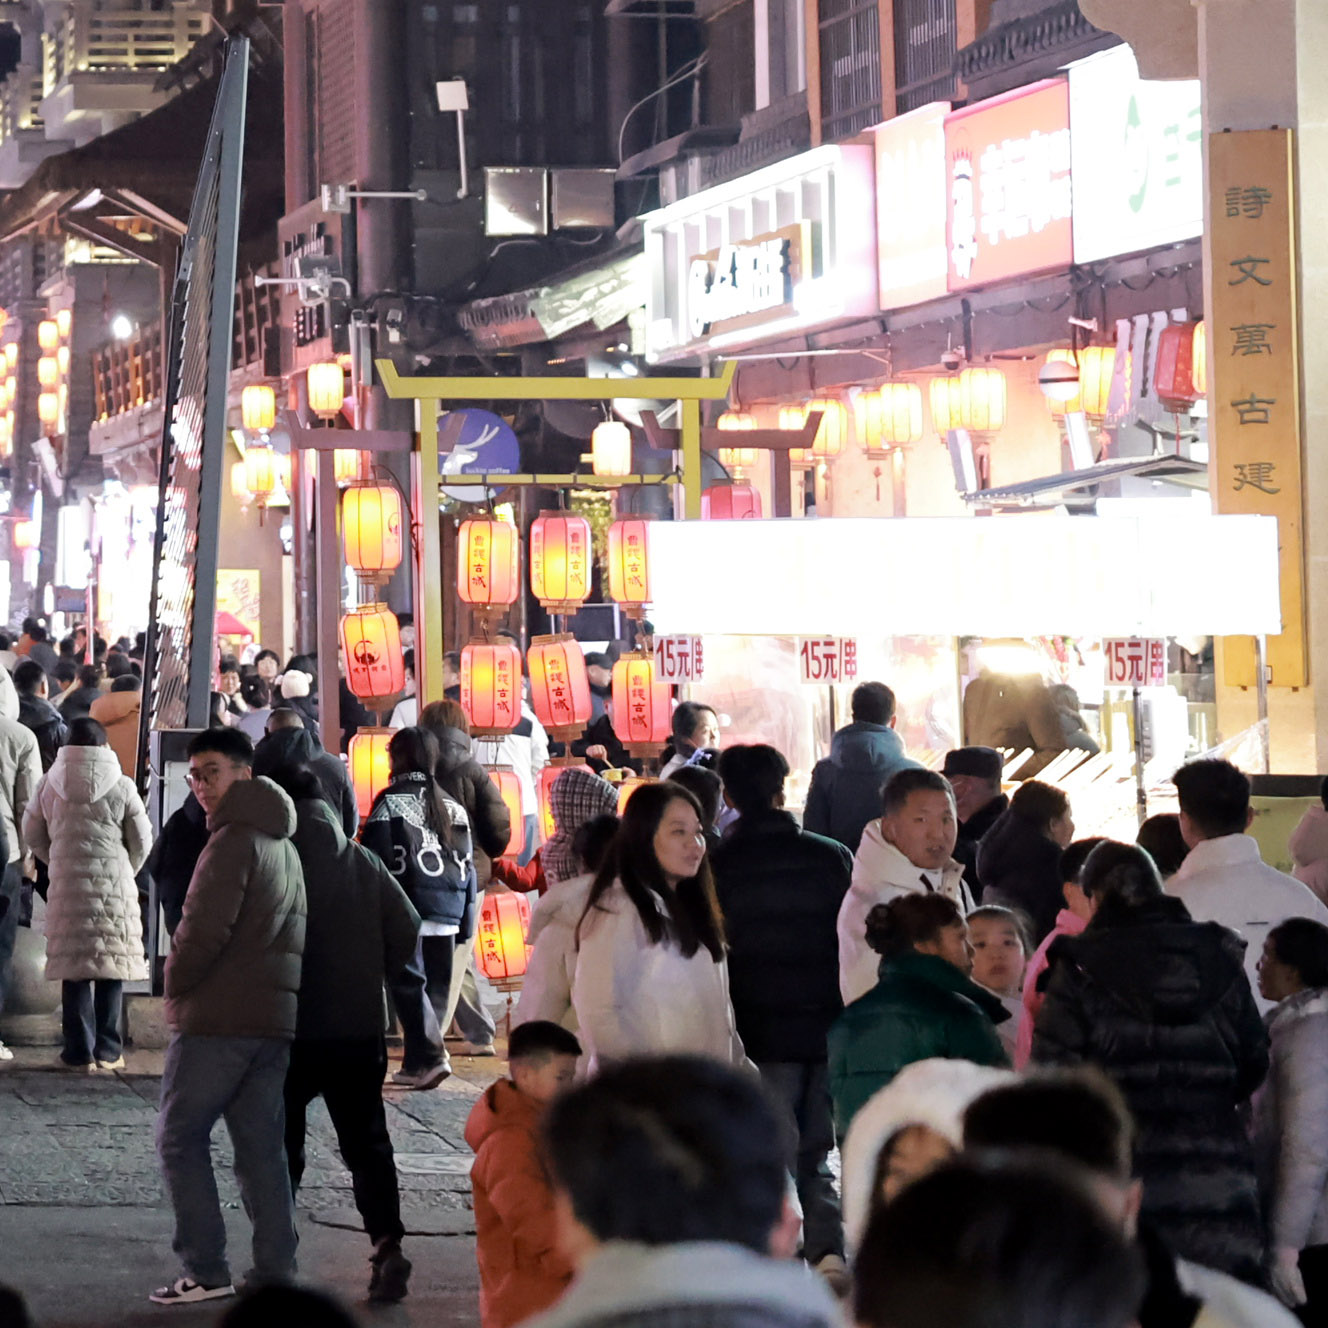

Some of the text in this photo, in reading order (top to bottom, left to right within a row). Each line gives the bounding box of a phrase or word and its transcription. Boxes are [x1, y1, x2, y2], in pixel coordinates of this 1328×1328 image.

[656, 637, 704, 681] 15元/串
[801, 638, 857, 682] 15元/串
[1104, 639, 1164, 685] 15元/串
